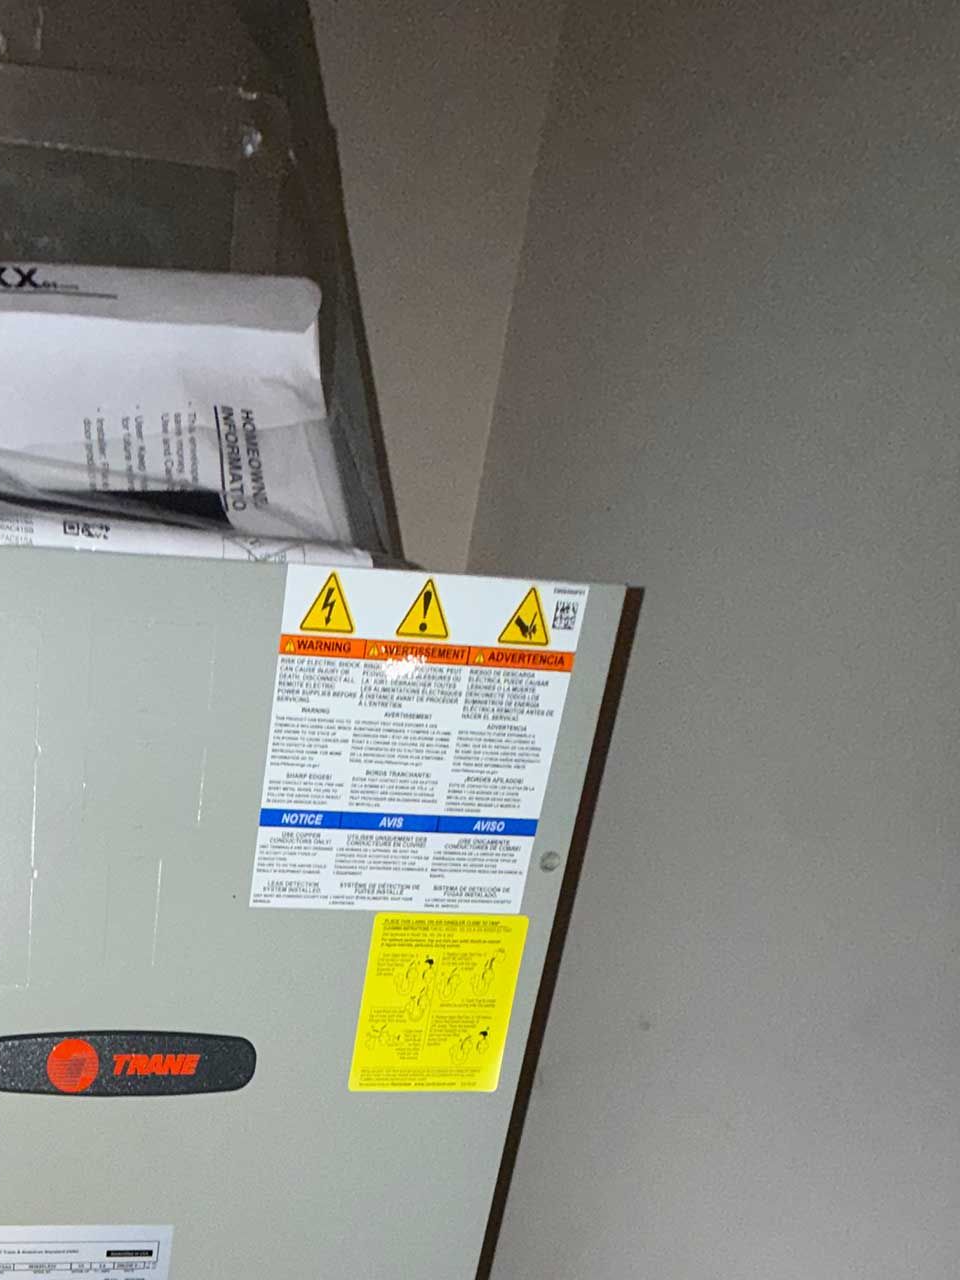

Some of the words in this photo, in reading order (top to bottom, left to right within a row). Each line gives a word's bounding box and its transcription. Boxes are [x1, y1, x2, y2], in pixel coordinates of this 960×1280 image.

[297, 640, 351, 652] WARNING
[382, 646, 466, 658] AVERTISSEMENT
[488, 652, 565, 665] ADVERTENCIA
[281, 813, 323, 825] NOTICE
[379, 816, 404, 828] AVIS
[473, 820, 505, 832] AVISO
[112, 1054, 201, 1075] TRANE
